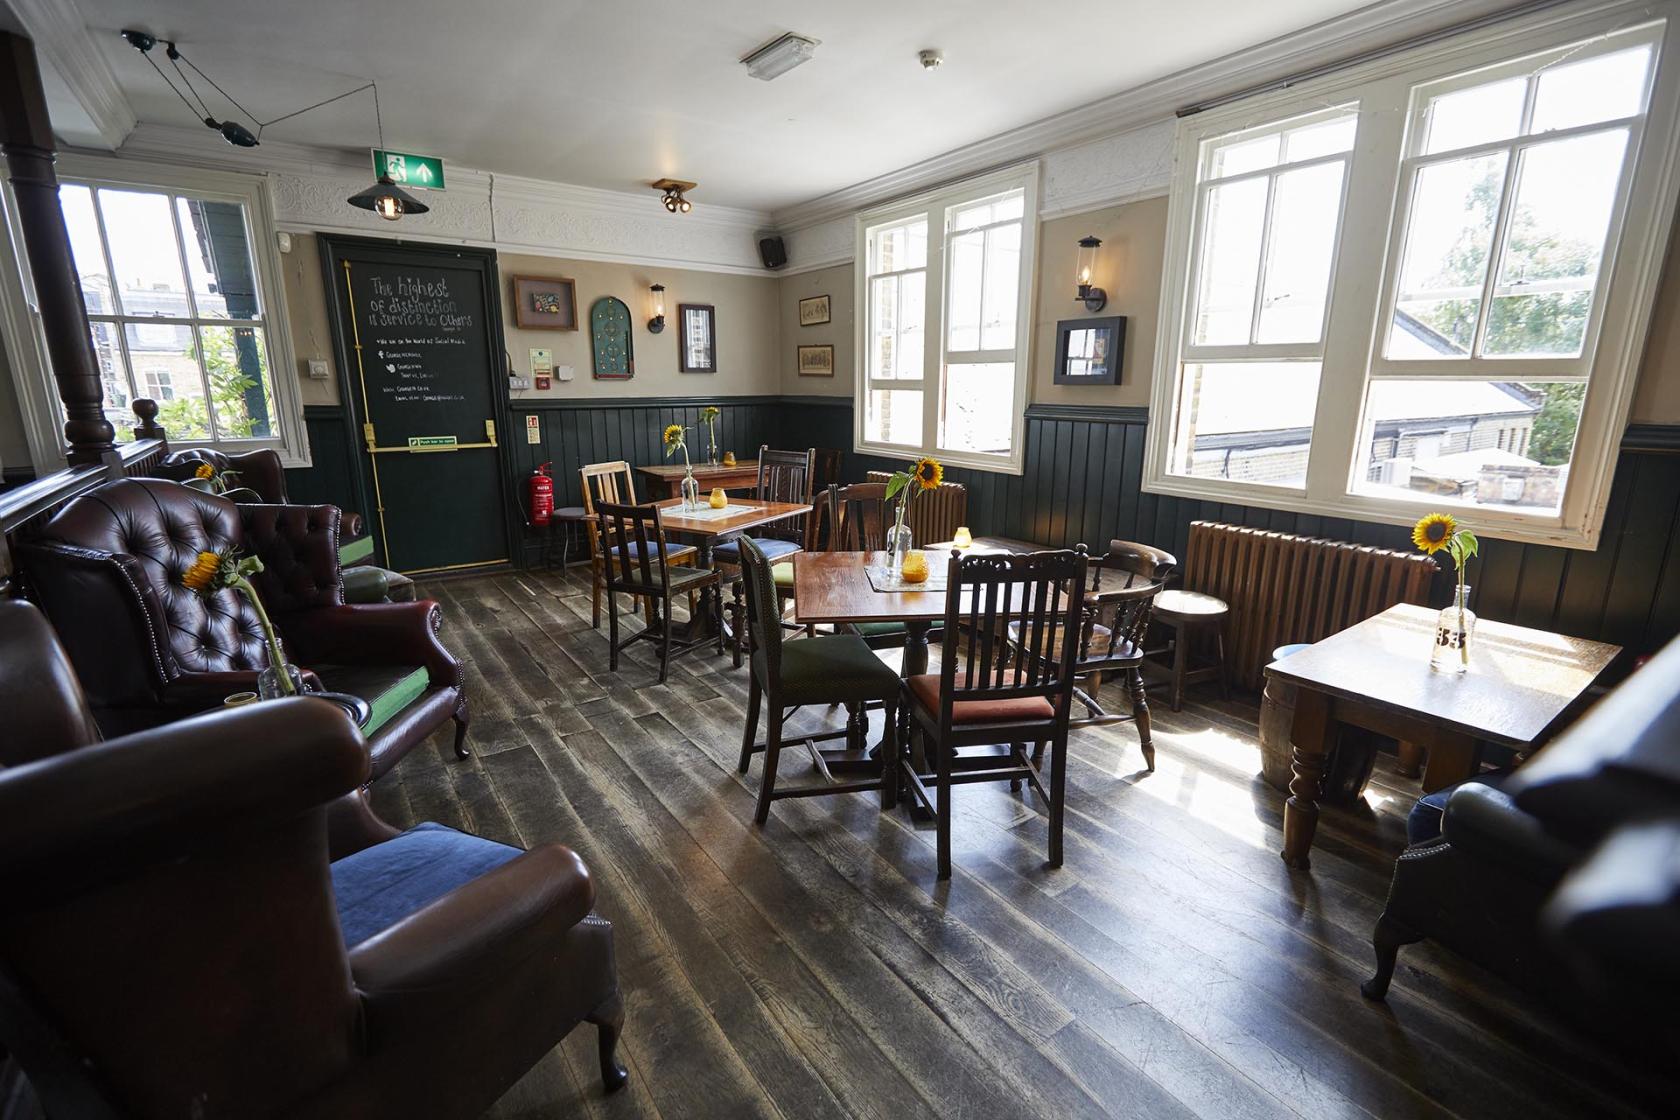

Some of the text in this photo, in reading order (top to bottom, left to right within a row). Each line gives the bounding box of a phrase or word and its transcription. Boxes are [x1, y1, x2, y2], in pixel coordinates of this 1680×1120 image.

[370, 276, 449, 303] The highest
[389, 297, 458, 315] distinction
